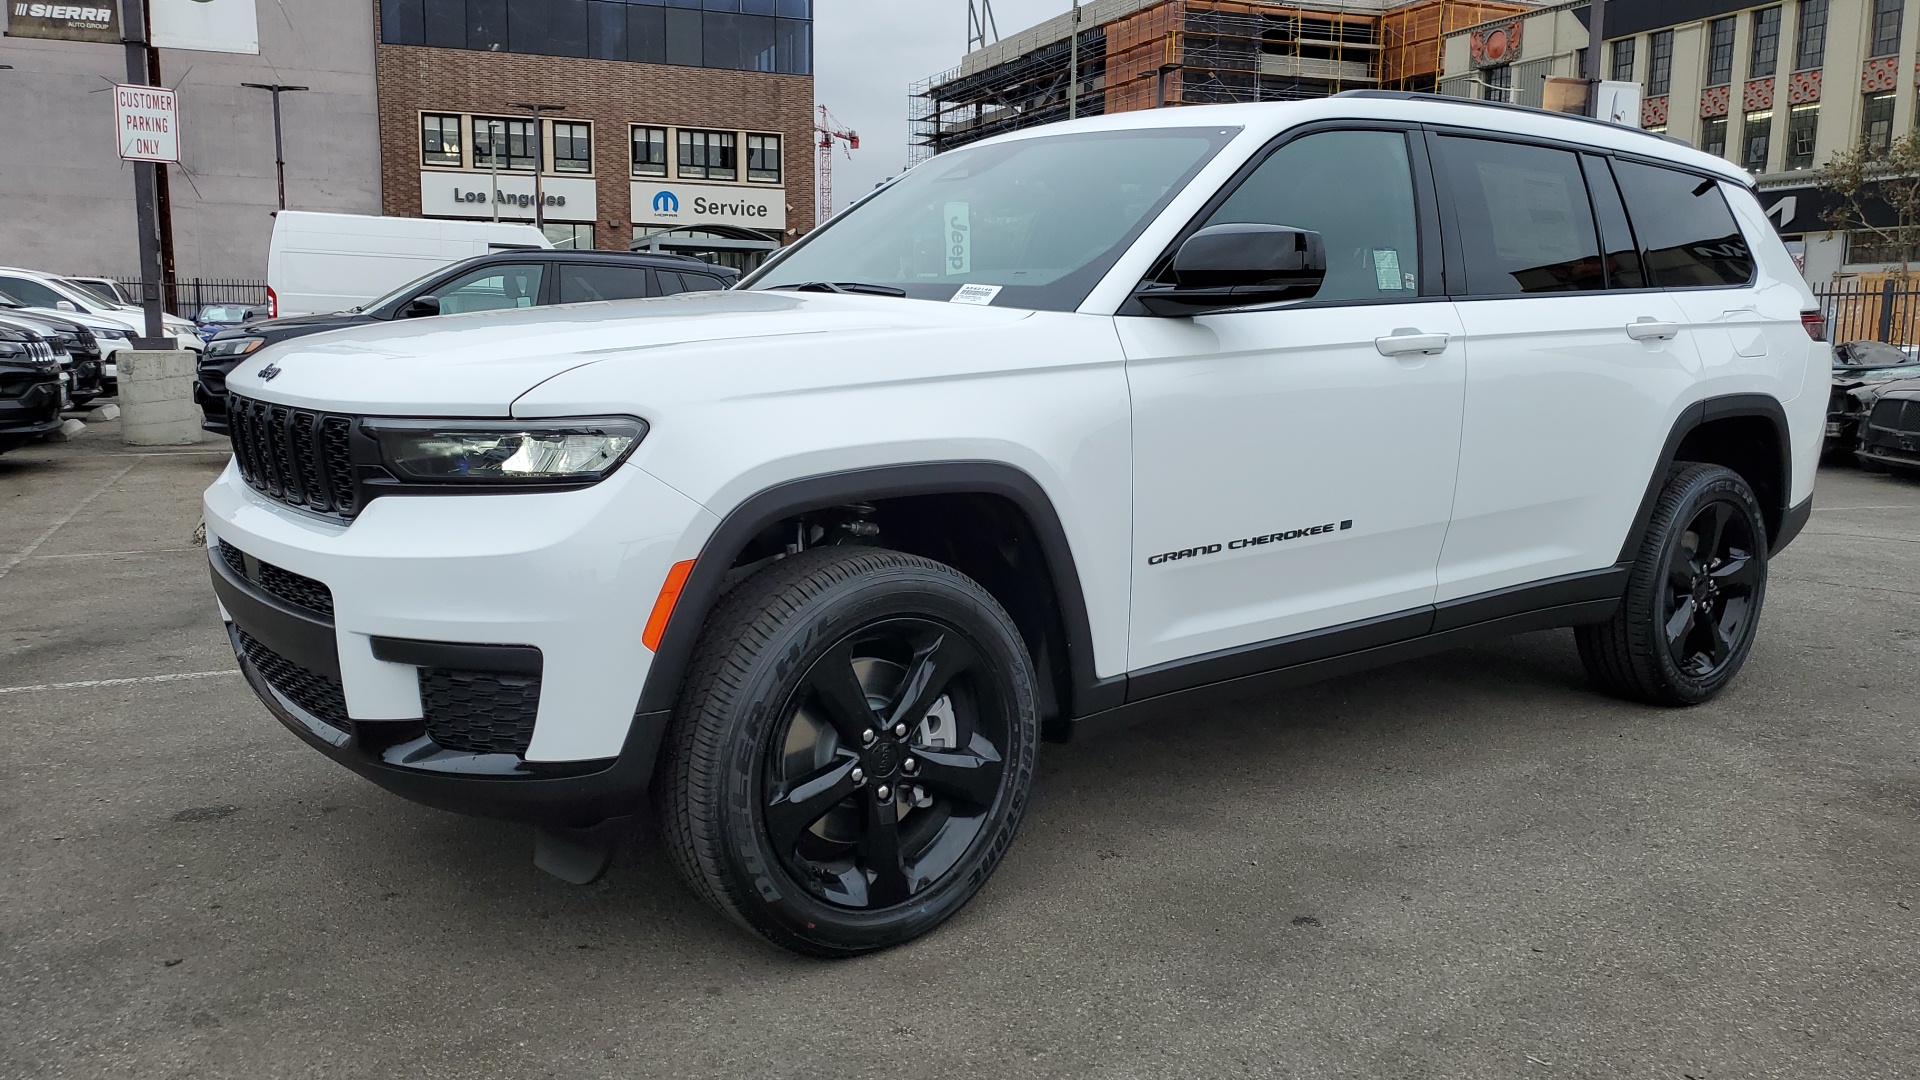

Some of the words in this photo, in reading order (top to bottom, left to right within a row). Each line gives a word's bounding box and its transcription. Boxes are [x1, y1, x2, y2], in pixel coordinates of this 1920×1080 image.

[29, 4, 112, 22] SIERRA
[119, 91, 173, 112] CUSTOMER
[126, 115, 169, 134] PARKING
[136, 138, 160, 156] ONLY
[454, 188, 486, 203] Los
[693, 197, 768, 218] Service
[948, 216, 968, 270] Jeep
[1147, 543, 1222, 566] GRAND
[1227, 523, 1335, 550] CHEROKEE
